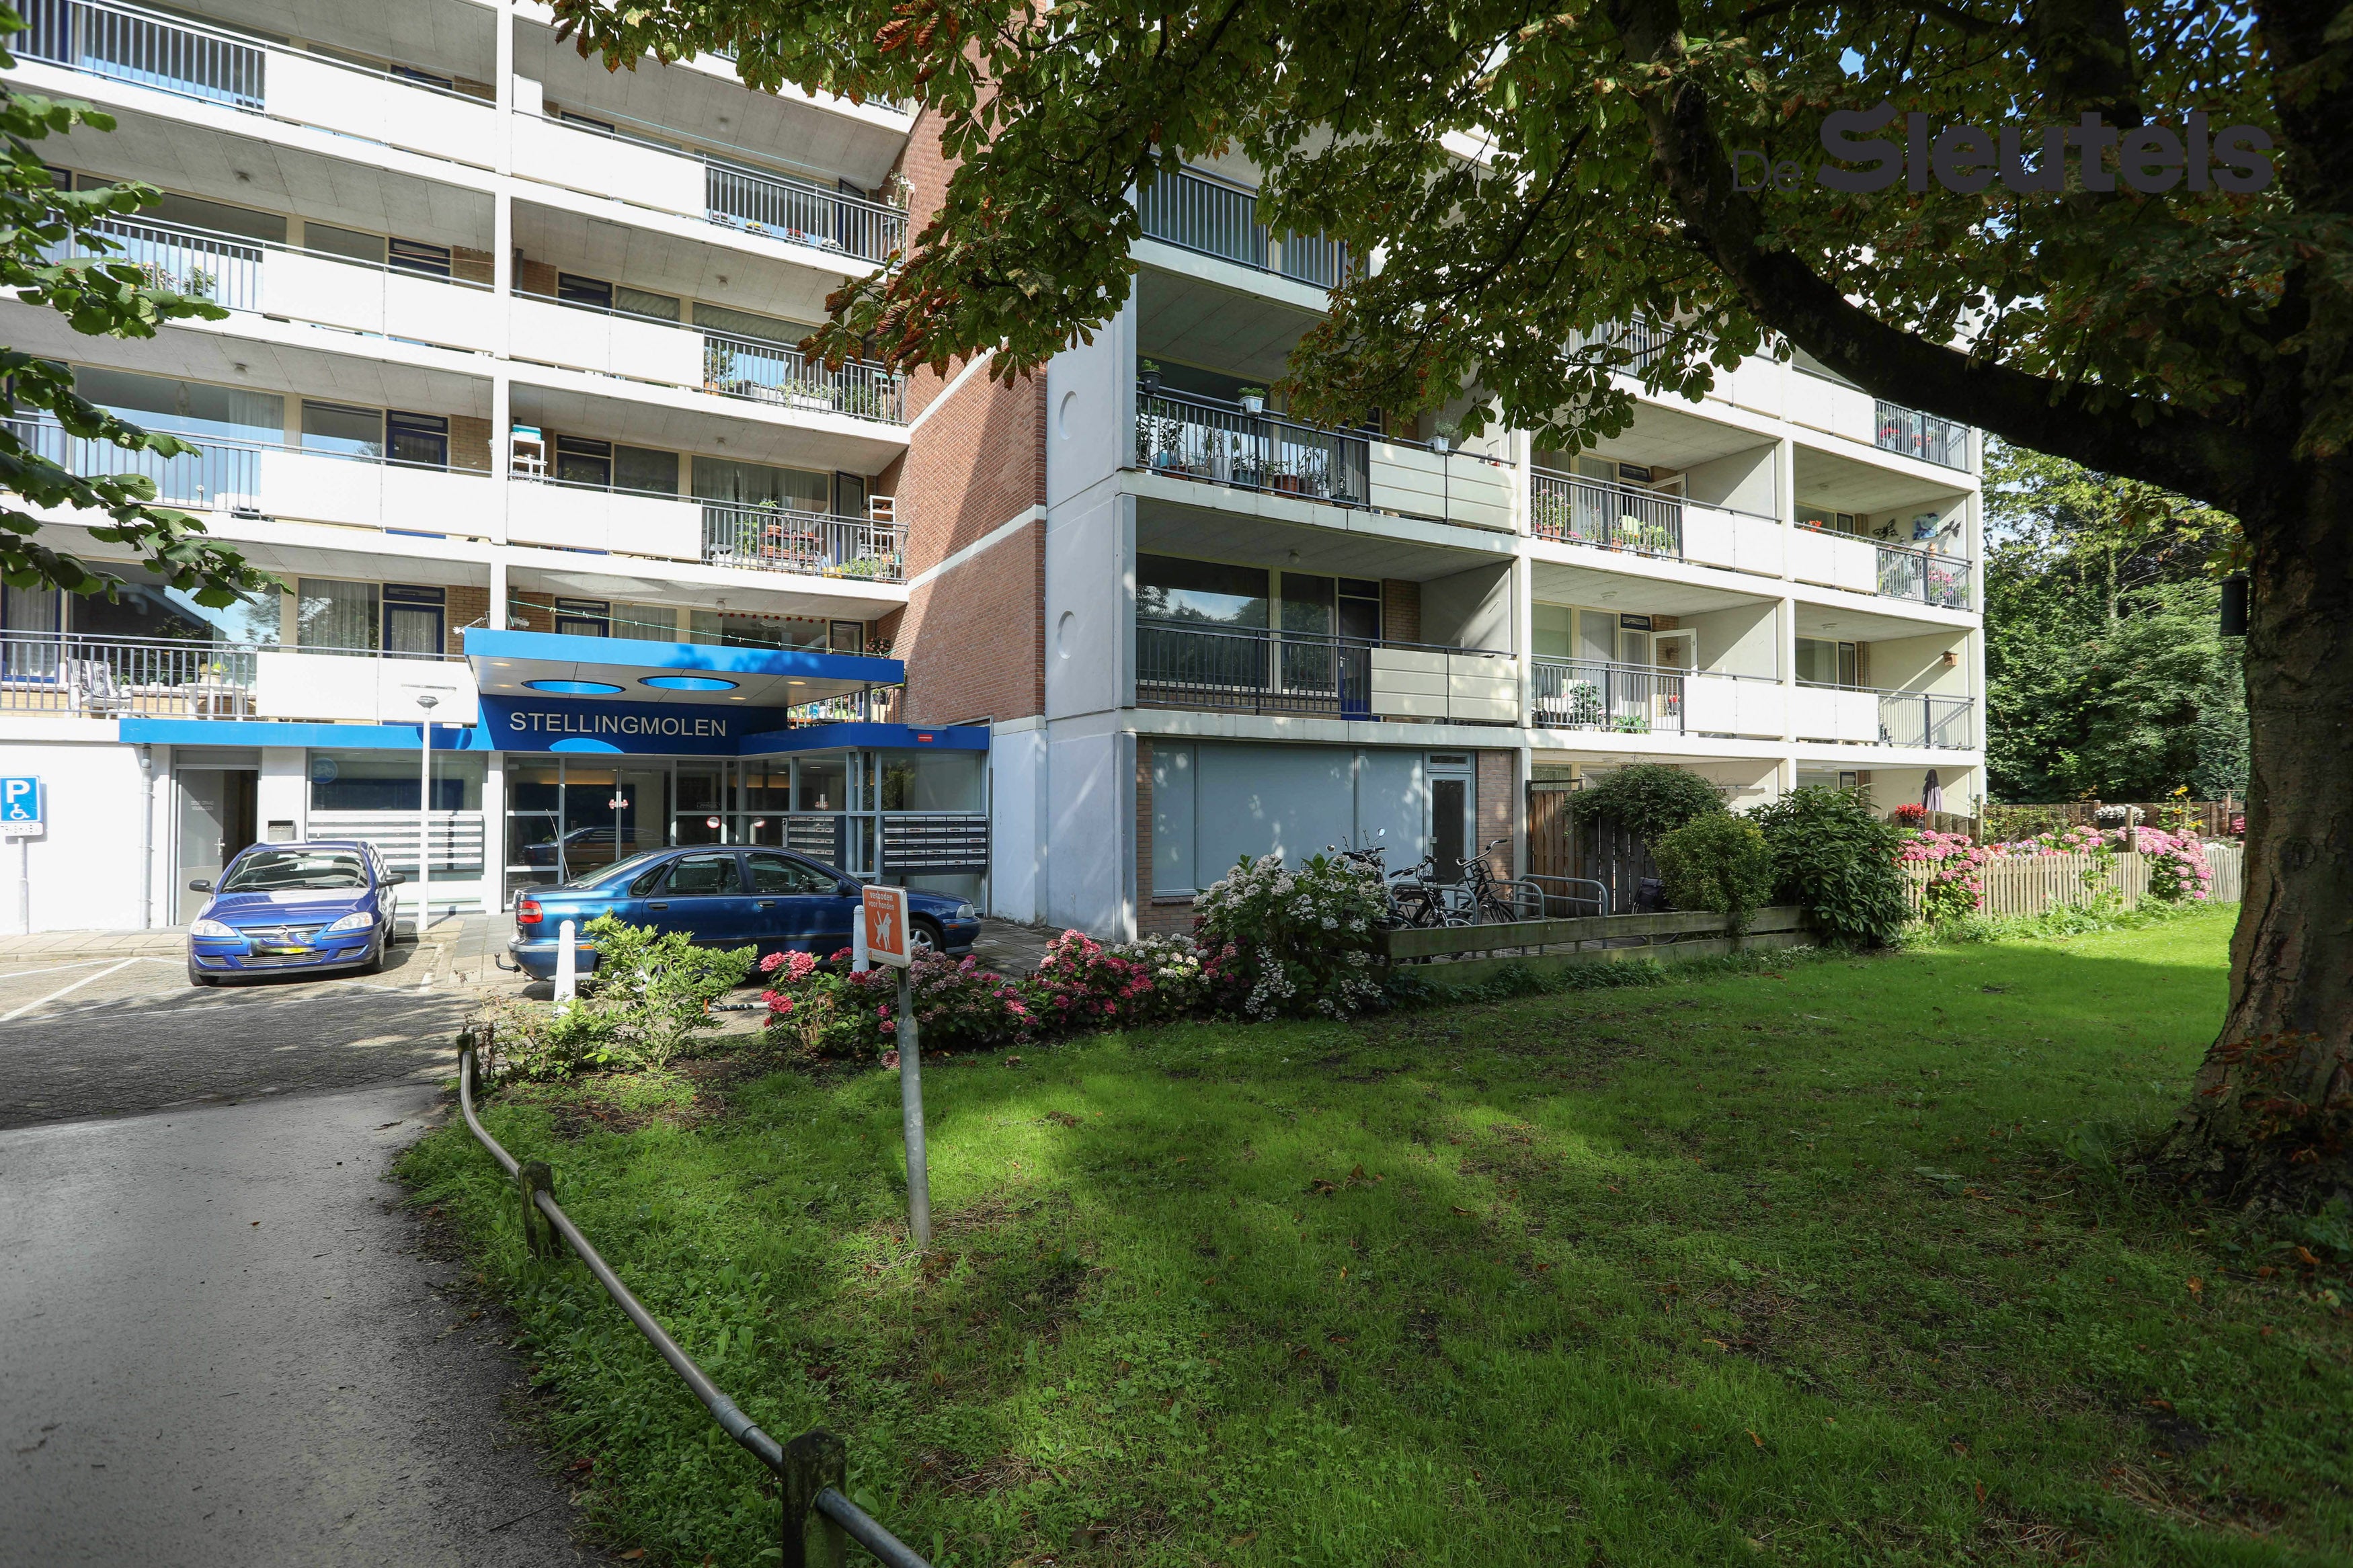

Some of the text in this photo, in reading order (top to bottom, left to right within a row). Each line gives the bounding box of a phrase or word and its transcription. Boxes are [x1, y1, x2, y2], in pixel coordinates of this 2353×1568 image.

[510, 712, 726, 737] STELLINGMOLEN
[6, 780, 30, 803] P
[869, 891, 893, 901] verboden
[879, 901, 894, 910] honden
